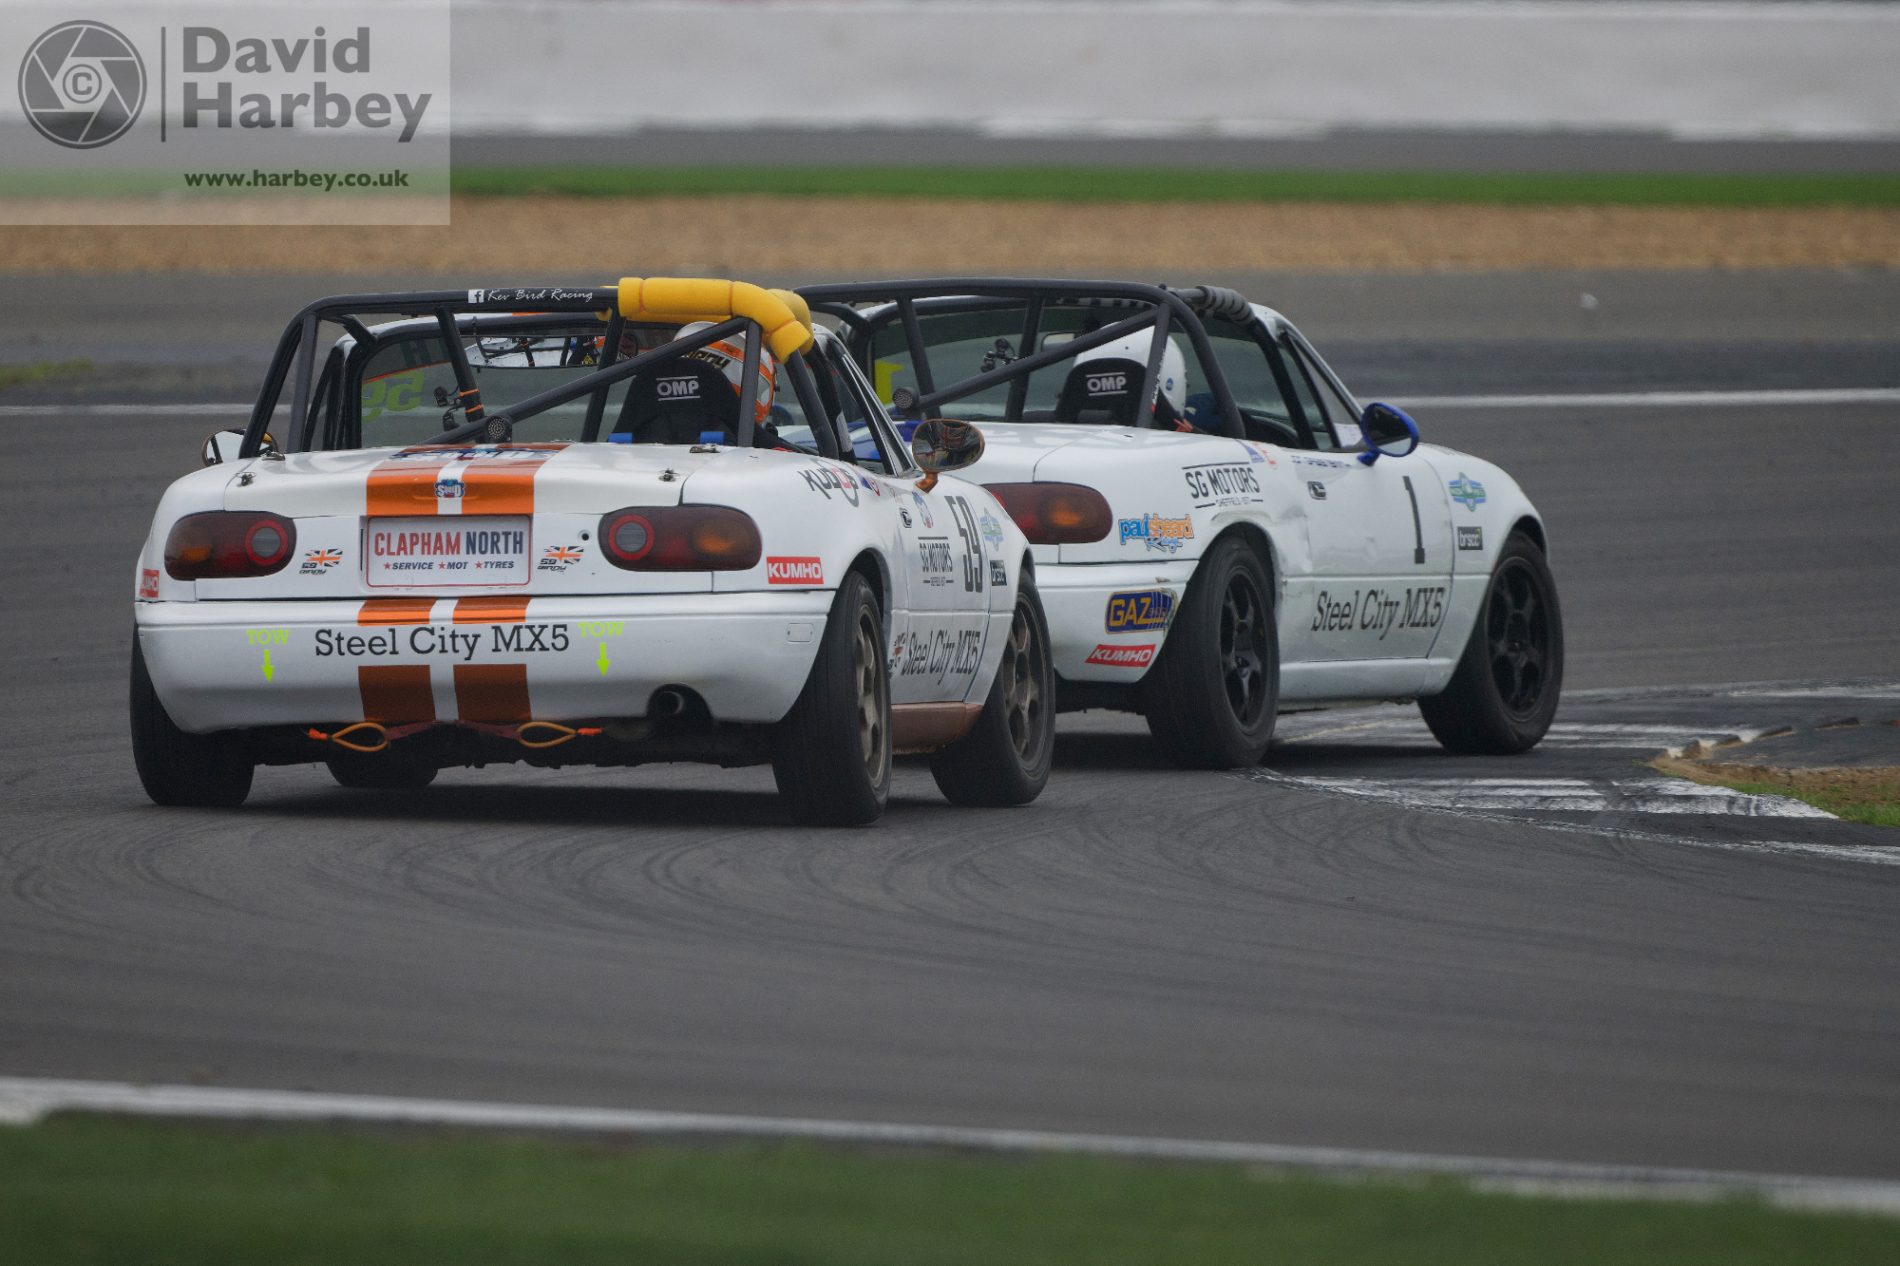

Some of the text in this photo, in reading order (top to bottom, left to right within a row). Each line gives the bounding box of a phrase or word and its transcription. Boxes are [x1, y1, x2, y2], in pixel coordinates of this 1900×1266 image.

[487, 289, 510, 302] Kev
[515, 289, 546, 301] Bird
[550, 289, 593, 302] Racing
[657, 380, 700, 397] OMP
[1087, 377, 1127, 392] OMP
[1185, 467, 1260, 499] SG MOTORS
[1403, 476, 1425, 564] 1
[374, 531, 523, 556] CLAPHAM NORTH
[944, 495, 983, 593] 59
[392, 560, 514, 570] SERVICE MOT TYRES
[768, 563, 822, 578] KUMHO
[1109, 596, 1164, 627] GAZ
[1311, 587, 1446, 641] Steel City MX5
[246, 629, 290, 646] TOW
[578, 622, 625, 638] TOW
[315, 624, 569, 660] Steel City MX5
[901, 630, 933, 676] Steel
[930, 629, 955, 686] City
[951, 630, 981, 675] MX5
[1091, 648, 1153, 664] KUMHO
